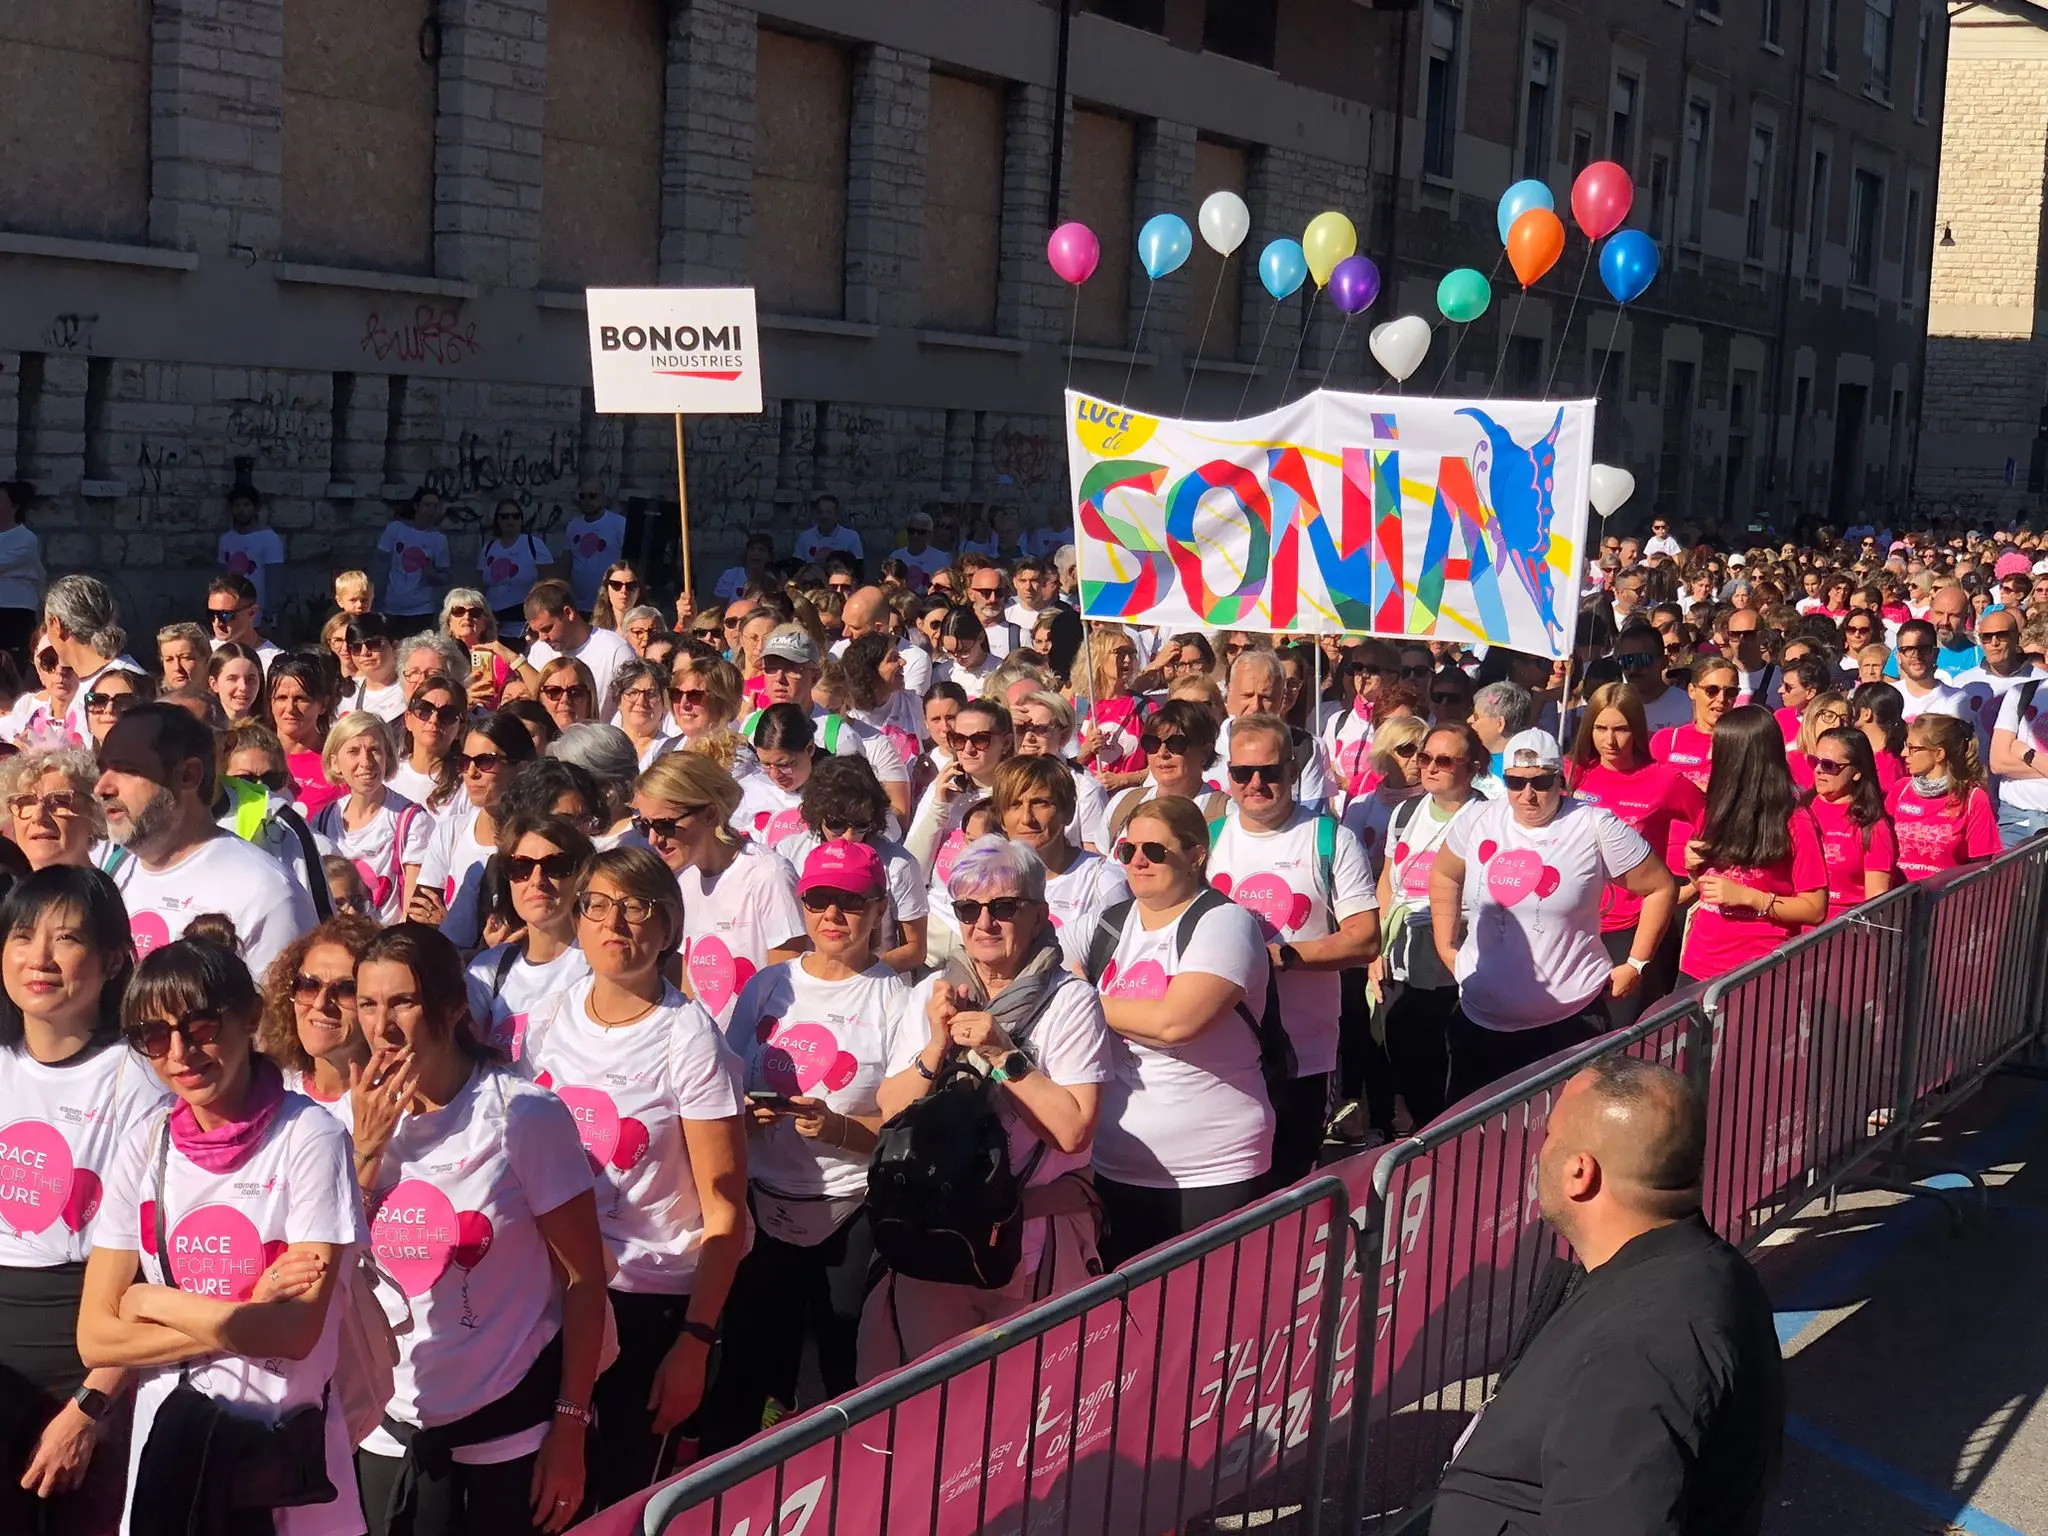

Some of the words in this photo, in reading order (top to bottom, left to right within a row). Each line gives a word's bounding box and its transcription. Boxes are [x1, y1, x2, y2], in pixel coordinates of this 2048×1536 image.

[600, 326, 741, 351] BONOMI
[651, 355, 743, 367] INDUSTRIES
[1078, 400, 1133, 432] LUCE
[1102, 432, 1124, 450] di
[1496, 858, 1527, 868] RACE
[1489, 876, 1521, 888] CURE
[1239, 889, 1274, 900] RACE
[692, 955, 717, 966] RACE
[779, 1037, 819, 1053] RACE
[767, 1058, 808, 1075] CURE
[0, 1164, 27, 1184] OR
[31, 1171, 66, 1195] THE
[0, 1184, 41, 1207] URE
[81, 1199, 98, 1221] 2025
[376, 1207, 427, 1225] RACE
[375, 1226, 411, 1244] FOR
[415, 1227, 452, 1244] THE
[176, 1236, 232, 1254] RACE
[377, 1244, 432, 1260] CURE
[176, 1257, 216, 1275] FOR
[219, 1258, 256, 1276] THE
[181, 1277, 232, 1296] CURE
